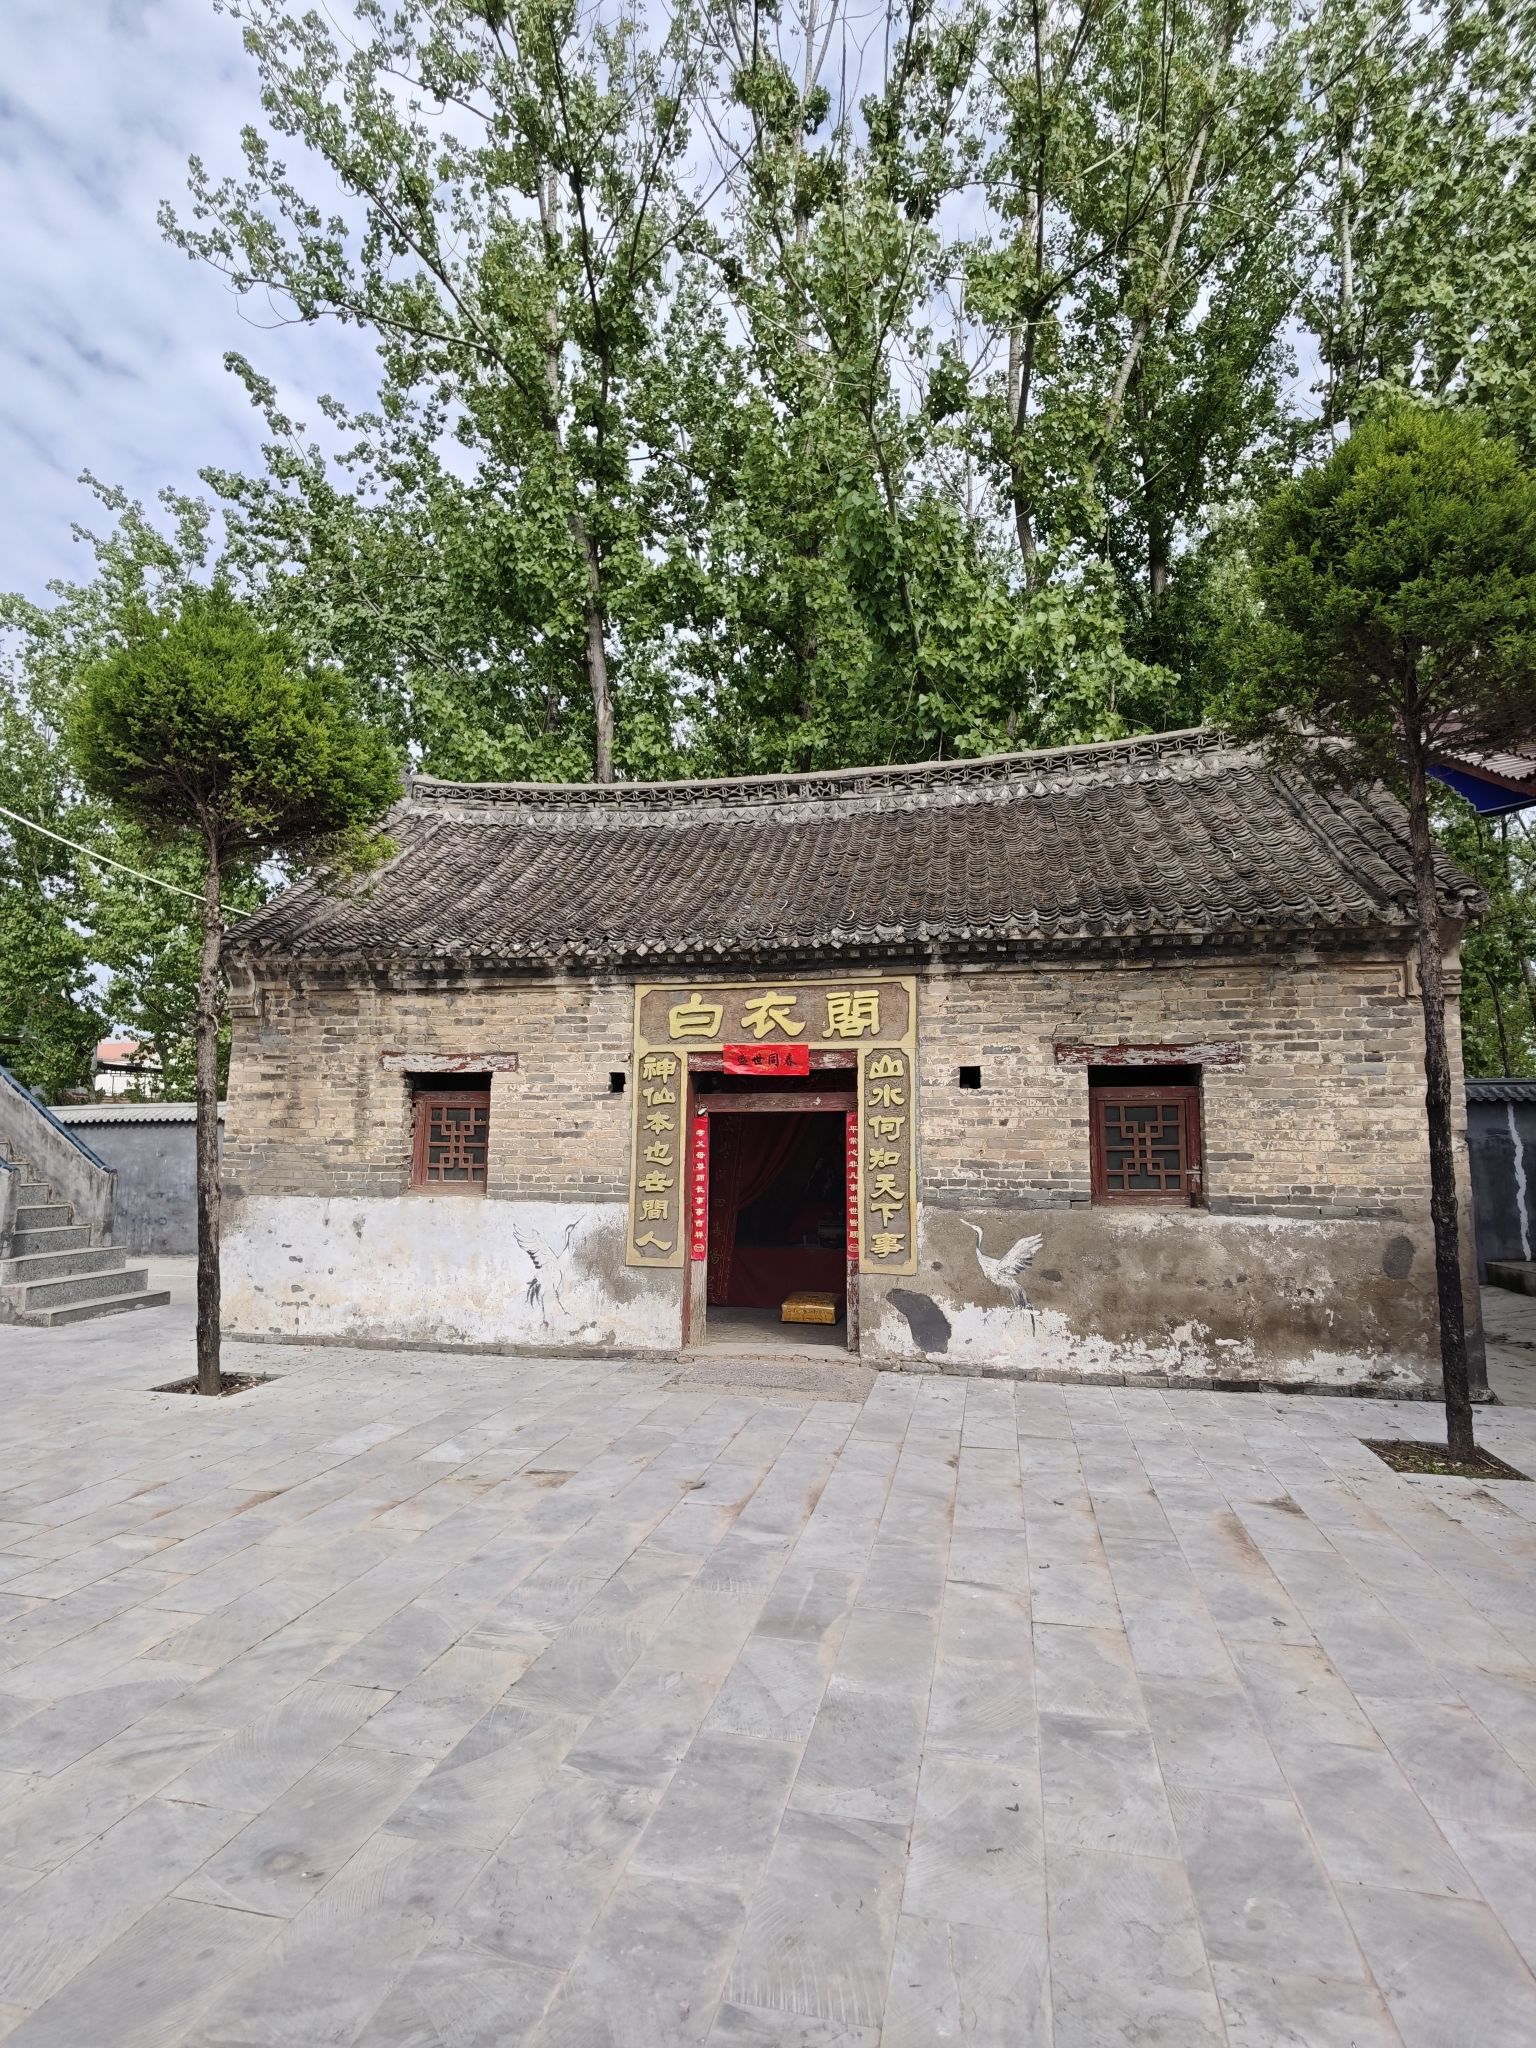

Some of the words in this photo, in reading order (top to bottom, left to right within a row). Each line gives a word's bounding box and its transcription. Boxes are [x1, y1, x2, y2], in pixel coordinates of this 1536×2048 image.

[668, 990, 880, 1039] 白衣閣
[737, 1053, 797, 1067] 盛世同春
[694, 1129, 706, 1239] 孝父母尊师长事事吉祥
[868, 1054, 906, 1258] 山水何知天下事
